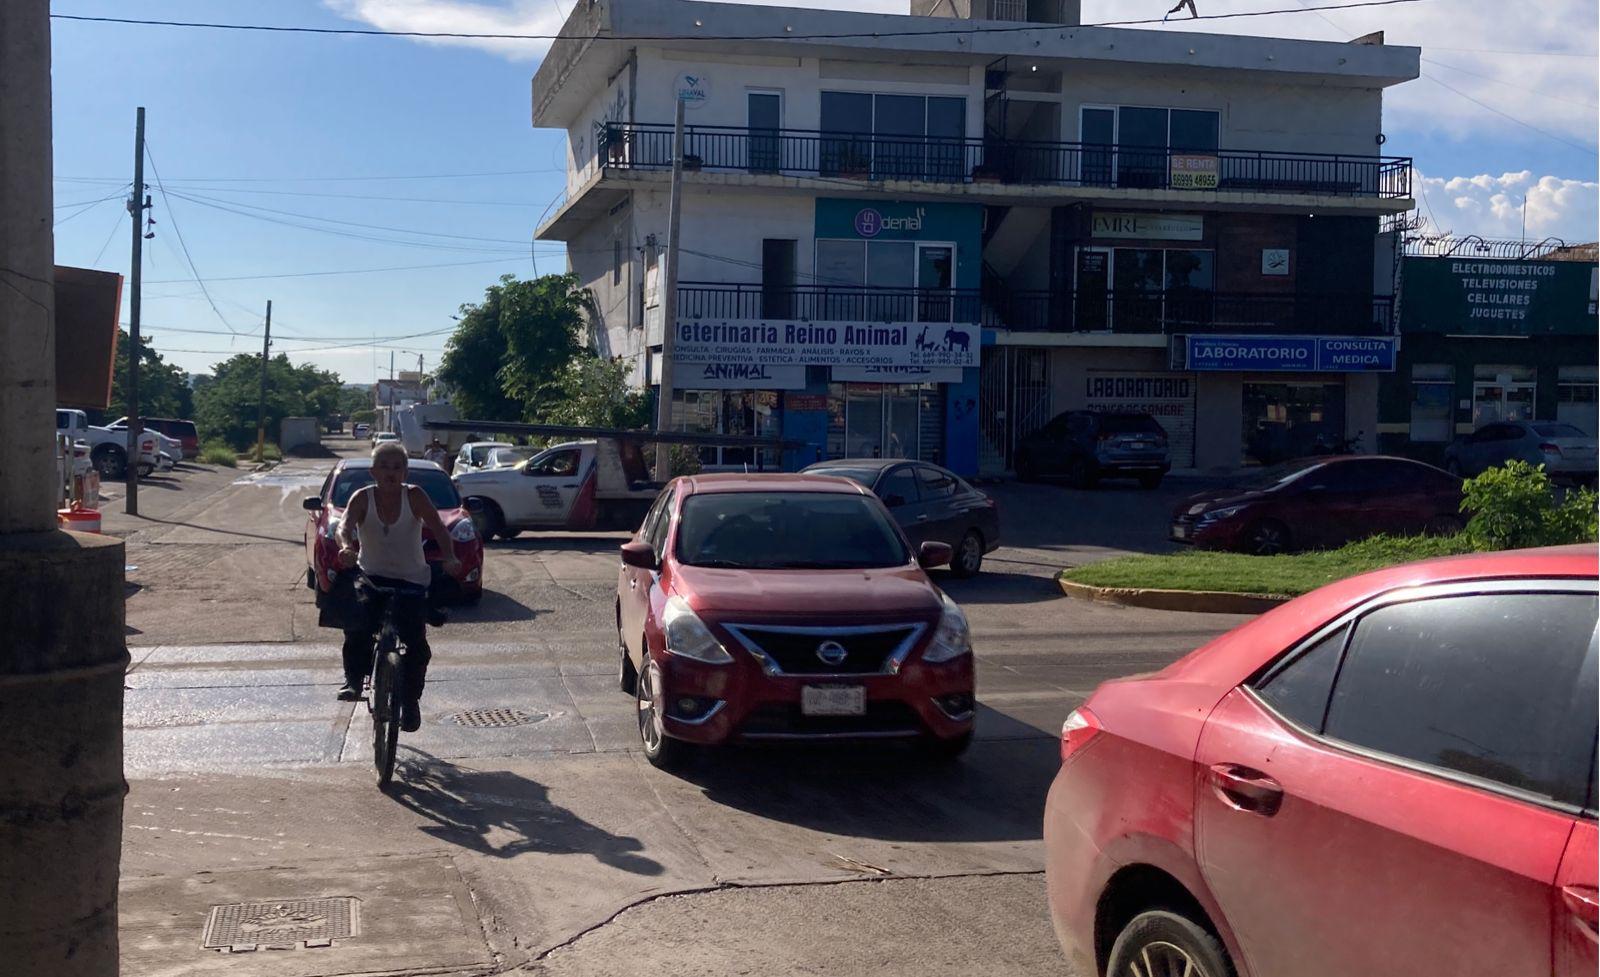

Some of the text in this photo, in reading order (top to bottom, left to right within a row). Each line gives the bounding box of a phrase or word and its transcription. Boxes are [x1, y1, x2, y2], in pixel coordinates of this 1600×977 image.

[1172, 158, 1215, 169] SE RENTA
[1451, 263, 1555, 277] ELECTRODOMESTICOS
[1462, 278, 1538, 290] TELEVISIONES
[1467, 293, 1530, 305] CELULARES
[1470, 308, 1526, 320] JUGUETES
[785, 324, 837, 345] Reino
[844, 325, 908, 346] Animal
[674, 345, 709, 353] ONSULTA
[1326, 341, 1386, 351] CONSULTA
[708, 354, 753, 362] PREVENTIVA
[799, 356, 840, 364] ALIMENTOS
[1194, 347, 1308, 359] LABORATORIO
[1332, 355, 1379, 364] MEDICA
[1086, 378, 1189, 398] LABORATORIO
